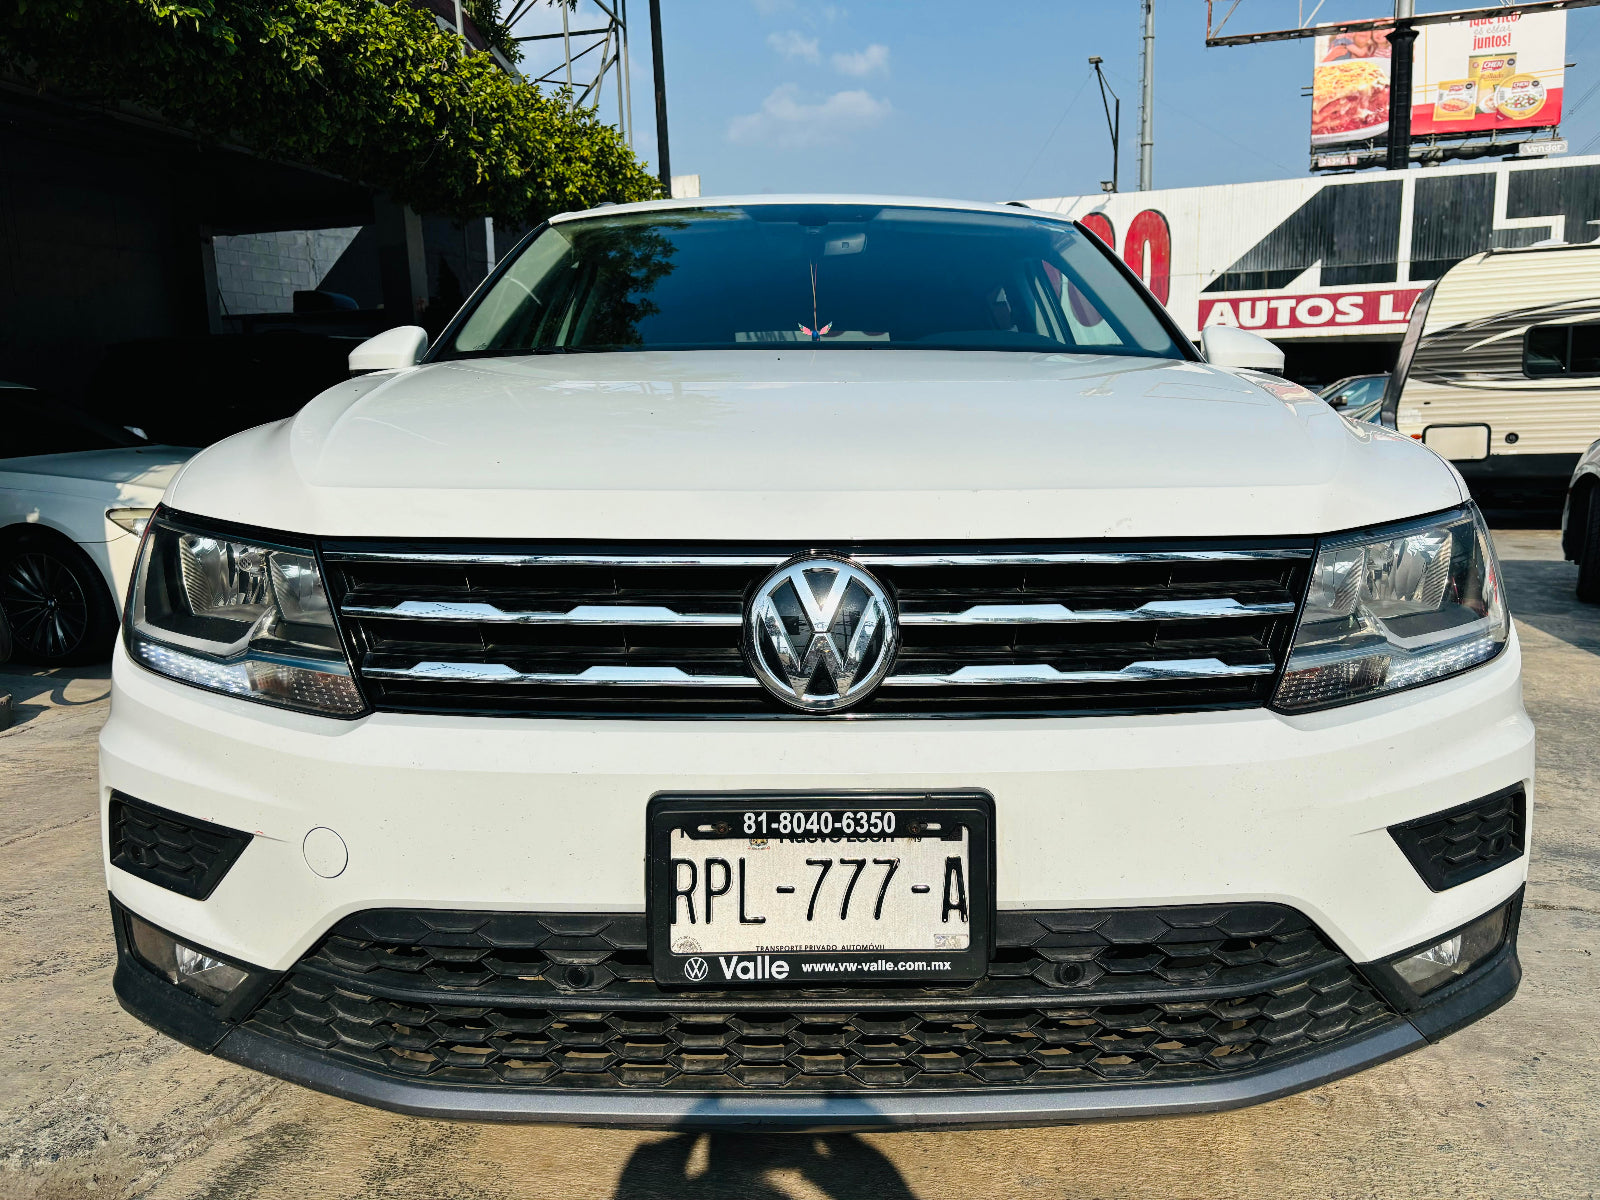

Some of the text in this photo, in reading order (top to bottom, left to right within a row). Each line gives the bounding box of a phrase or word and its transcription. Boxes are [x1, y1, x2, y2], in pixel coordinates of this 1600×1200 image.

[1472, 32, 1512, 51] juntos!
[1203, 295, 1364, 328] AUTOS
[743, 811, 896, 834] 81-8040-6350
[719, 955, 790, 980] Valle
[801, 960, 952, 973] www.vw-valle.com.mx
